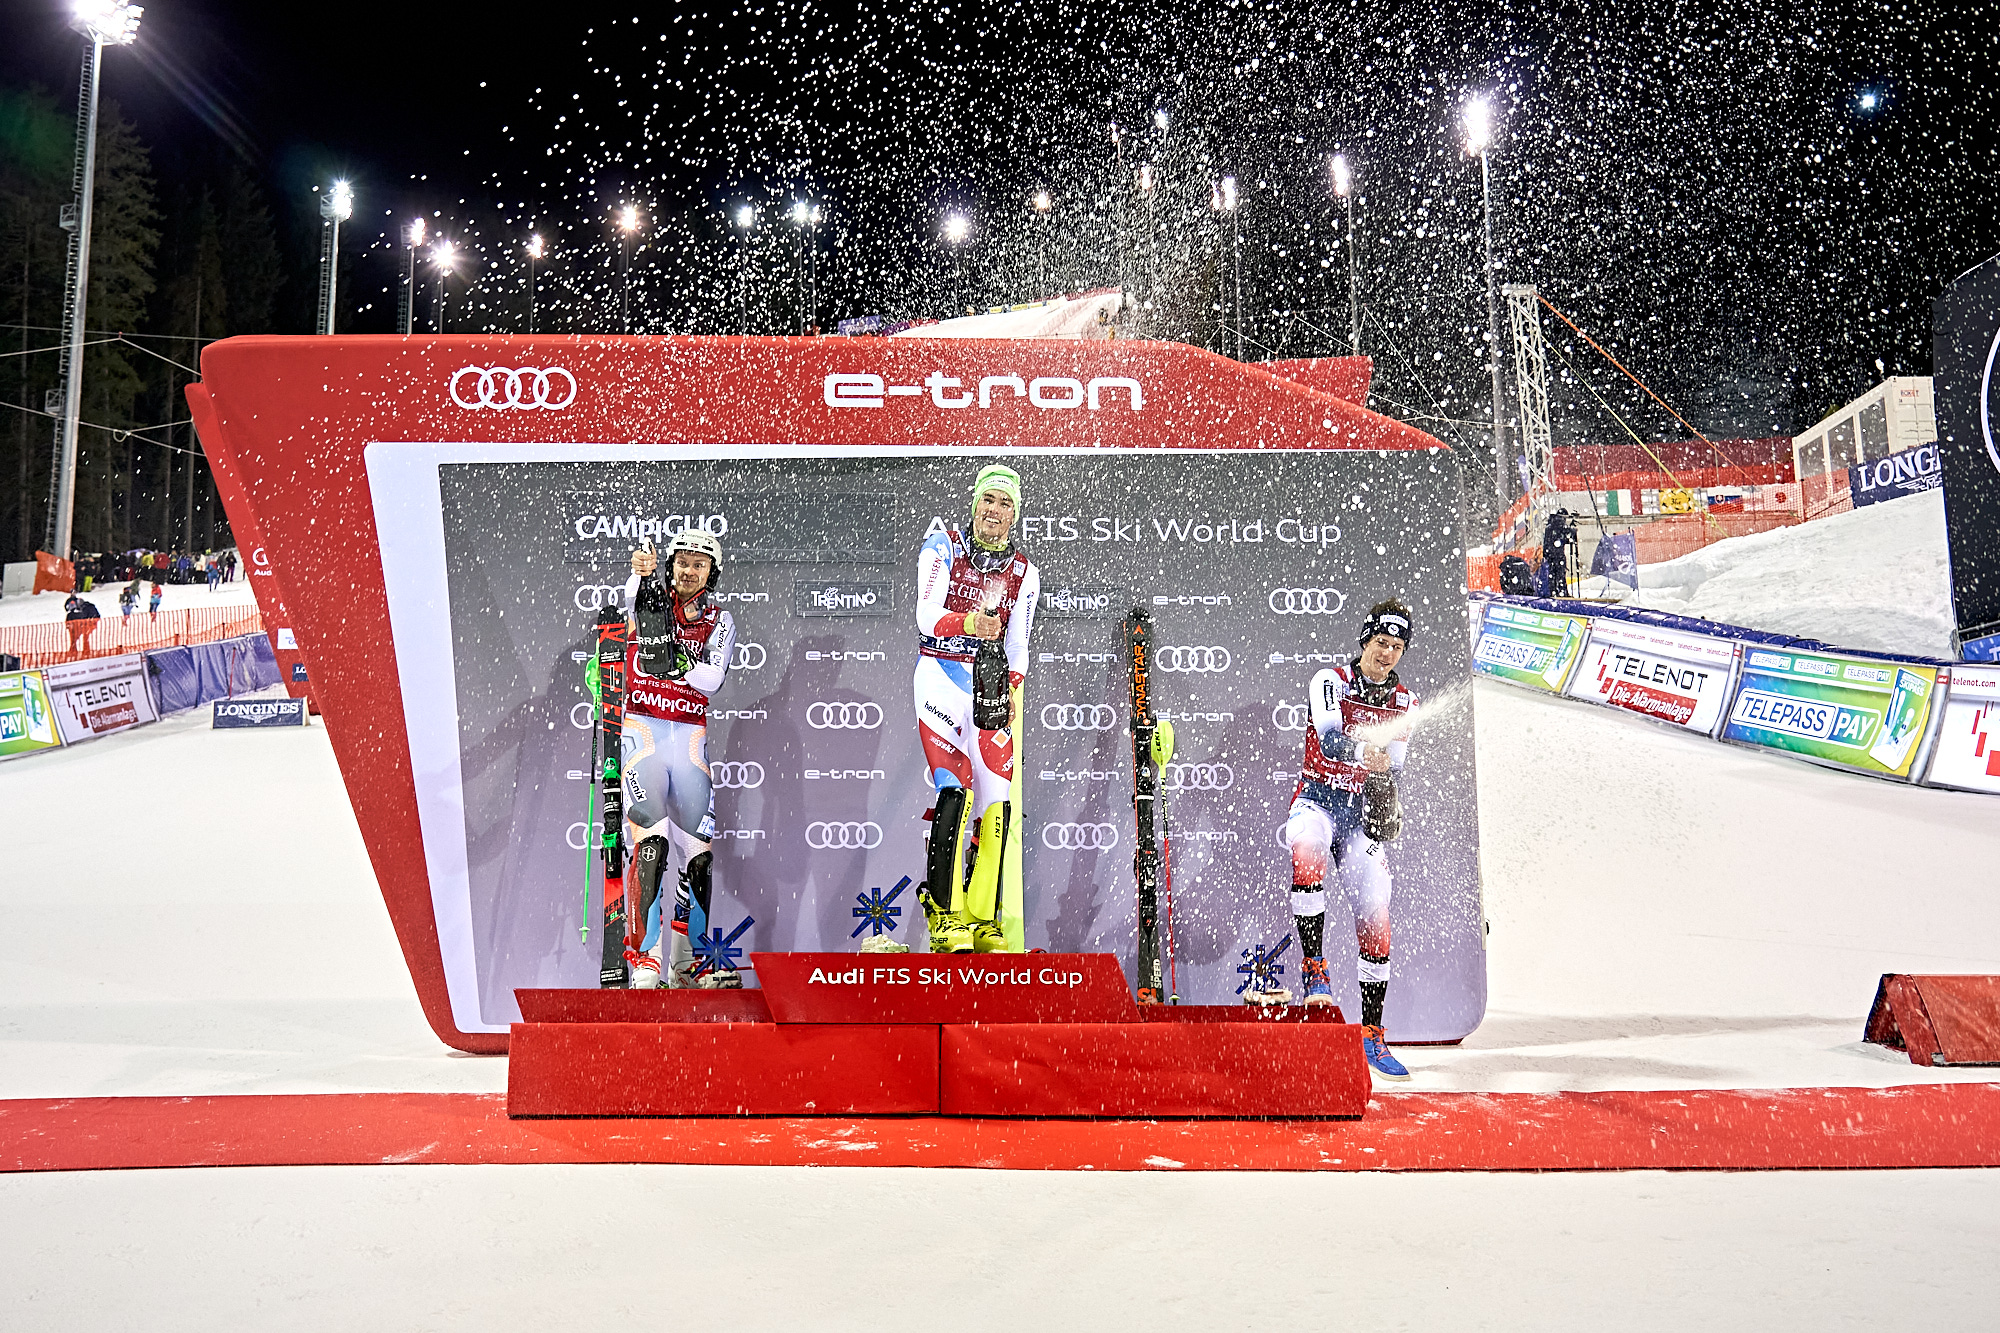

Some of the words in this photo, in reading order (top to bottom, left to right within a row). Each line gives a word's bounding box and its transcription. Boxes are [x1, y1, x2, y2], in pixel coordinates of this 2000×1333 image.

[823, 371, 1143, 411] e-tron
[1022, 517, 1079, 541] FIS
[1091, 516, 1141, 542] Ski
[1153, 516, 1263, 542] World
[1275, 517, 1342, 548] Cup
[254, 569, 272, 577] Aud
[707, 592, 769, 602] -tron
[811, 589, 877, 611] TRENTINO
[1045, 590, 1110, 611] TRENTINO
[1153, 594, 1232, 606] e-tron
[805, 650, 886, 661] e-tron
[1039, 652, 1118, 663] e-tron
[1269, 652, 1347, 664] e-tron
[1481, 639, 1528, 664] TELEPASS
[1752, 655, 1779, 667] TELEPASS
[1778, 658, 1790, 668] PAY
[1797, 660, 1825, 673] TELEPASS
[1825, 664, 1838, 675] PAY
[1614, 654, 1708, 692] TELENOT
[1846, 668, 1875, 680] TELEPASS
[1877, 671, 1890, 682] PAY
[633, 678, 647, 686] Audi
[648, 680, 660, 688] FIS
[1899, 679, 1926, 697] SKIPASS
[1952, 677, 1996, 688] telenot.com
[75, 681, 132, 707] TELENOT
[216, 702, 300, 717] LONGINES
[1613, 686, 1631, 703] Die
[1629, 691, 1692, 722] Alarmanlage
[706, 710, 768, 720] -tron
[924, 700, 955, 727] helvetia
[1157, 711, 1234, 721] e-tron
[1741, 697, 1828, 732] TELEPASS
[1834, 712, 1876, 742] PAY
[0, 713, 22, 735] PAY
[804, 769, 885, 780] e-tron
[1040, 770, 1119, 780] e-tron
[1158, 830, 1237, 841] e-tron
[808, 968, 865, 985] Audi
[872, 968, 911, 985] FIS
[918, 968, 952, 985] Ski
[958, 968, 1032, 985] World
[1038, 968, 1084, 988] Cup
[1153, 958, 1162, 989] SPEED
